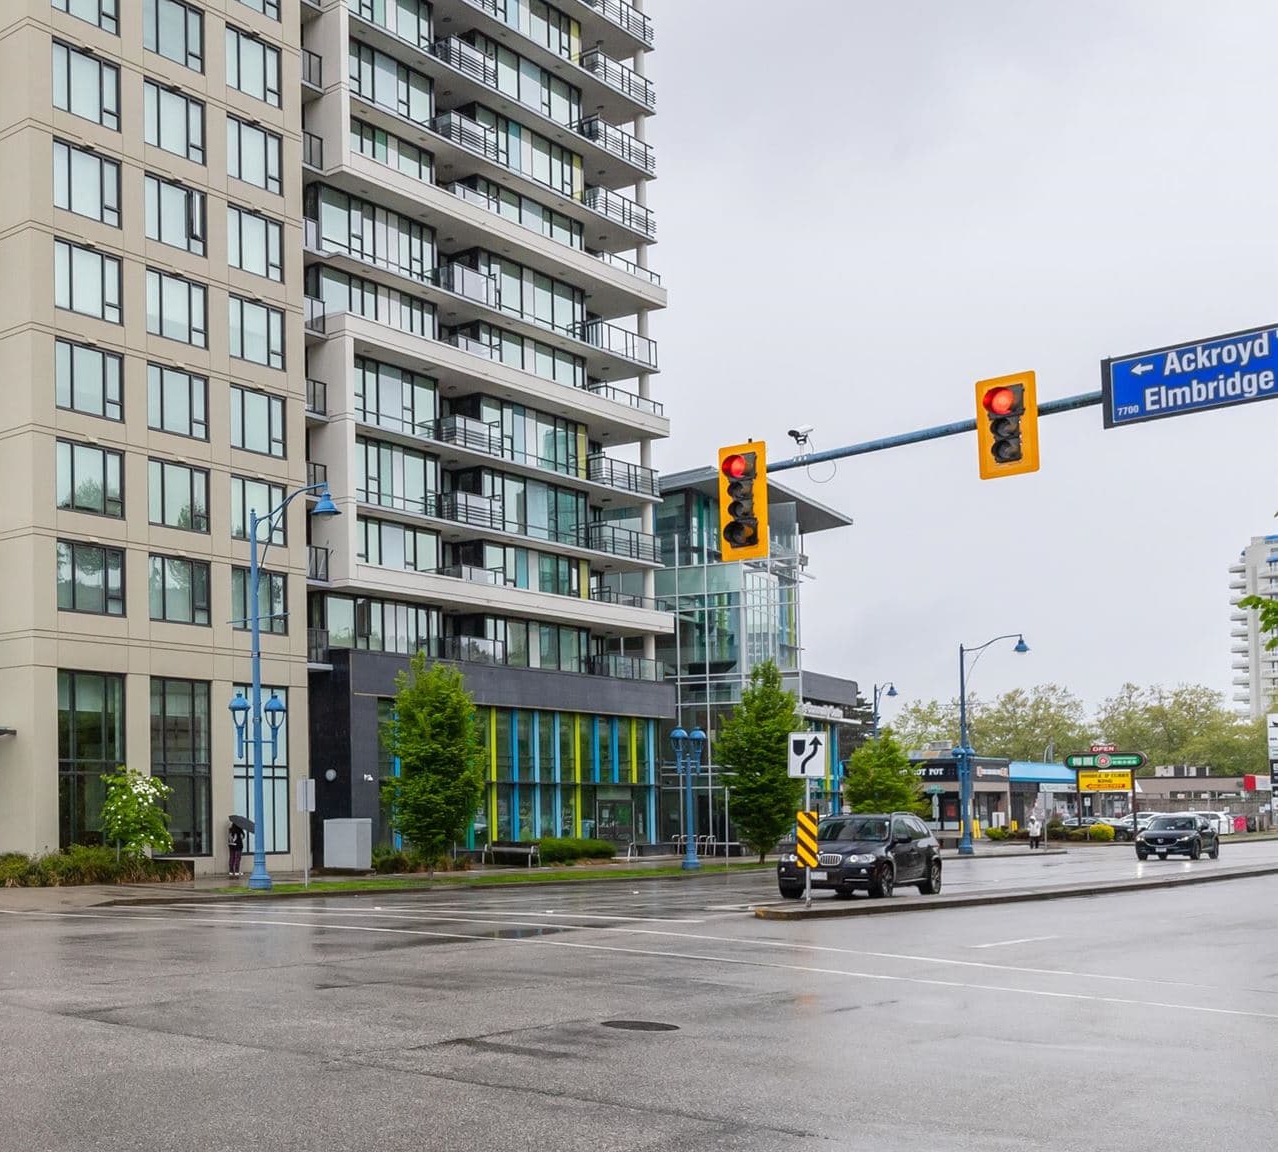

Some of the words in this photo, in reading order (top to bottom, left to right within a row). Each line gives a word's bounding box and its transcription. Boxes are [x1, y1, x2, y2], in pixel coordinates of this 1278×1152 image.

[1164, 332, 1269, 376] Ackroyd
[1145, 370, 1274, 411] Elmbridge
[1117, 405, 1139, 416] 7700
[928, 768, 944, 776] POT
